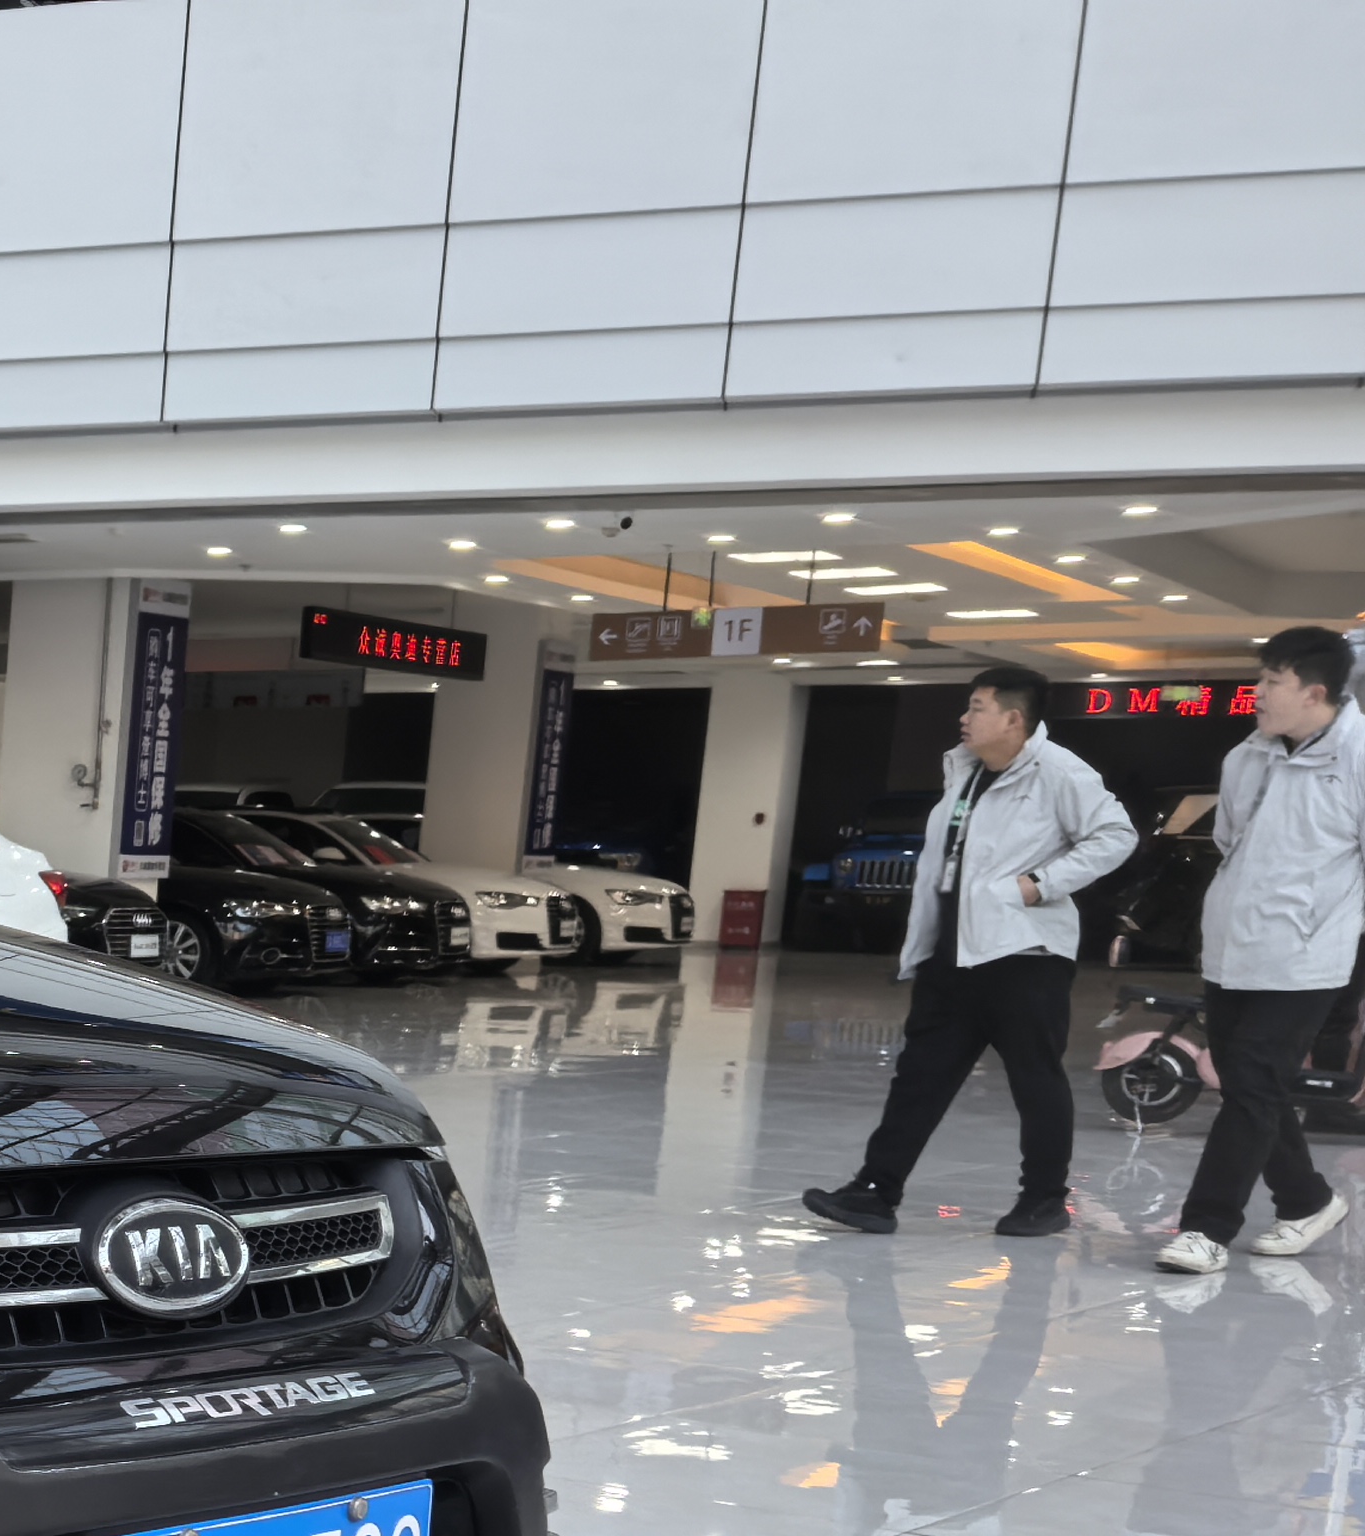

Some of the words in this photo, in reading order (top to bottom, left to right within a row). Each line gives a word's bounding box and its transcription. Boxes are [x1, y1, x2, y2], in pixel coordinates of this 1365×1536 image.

[723, 618, 754, 643] 1F
[124, 1223, 232, 1287] KIA
[119, 1371, 377, 1430] SPORTAGE
